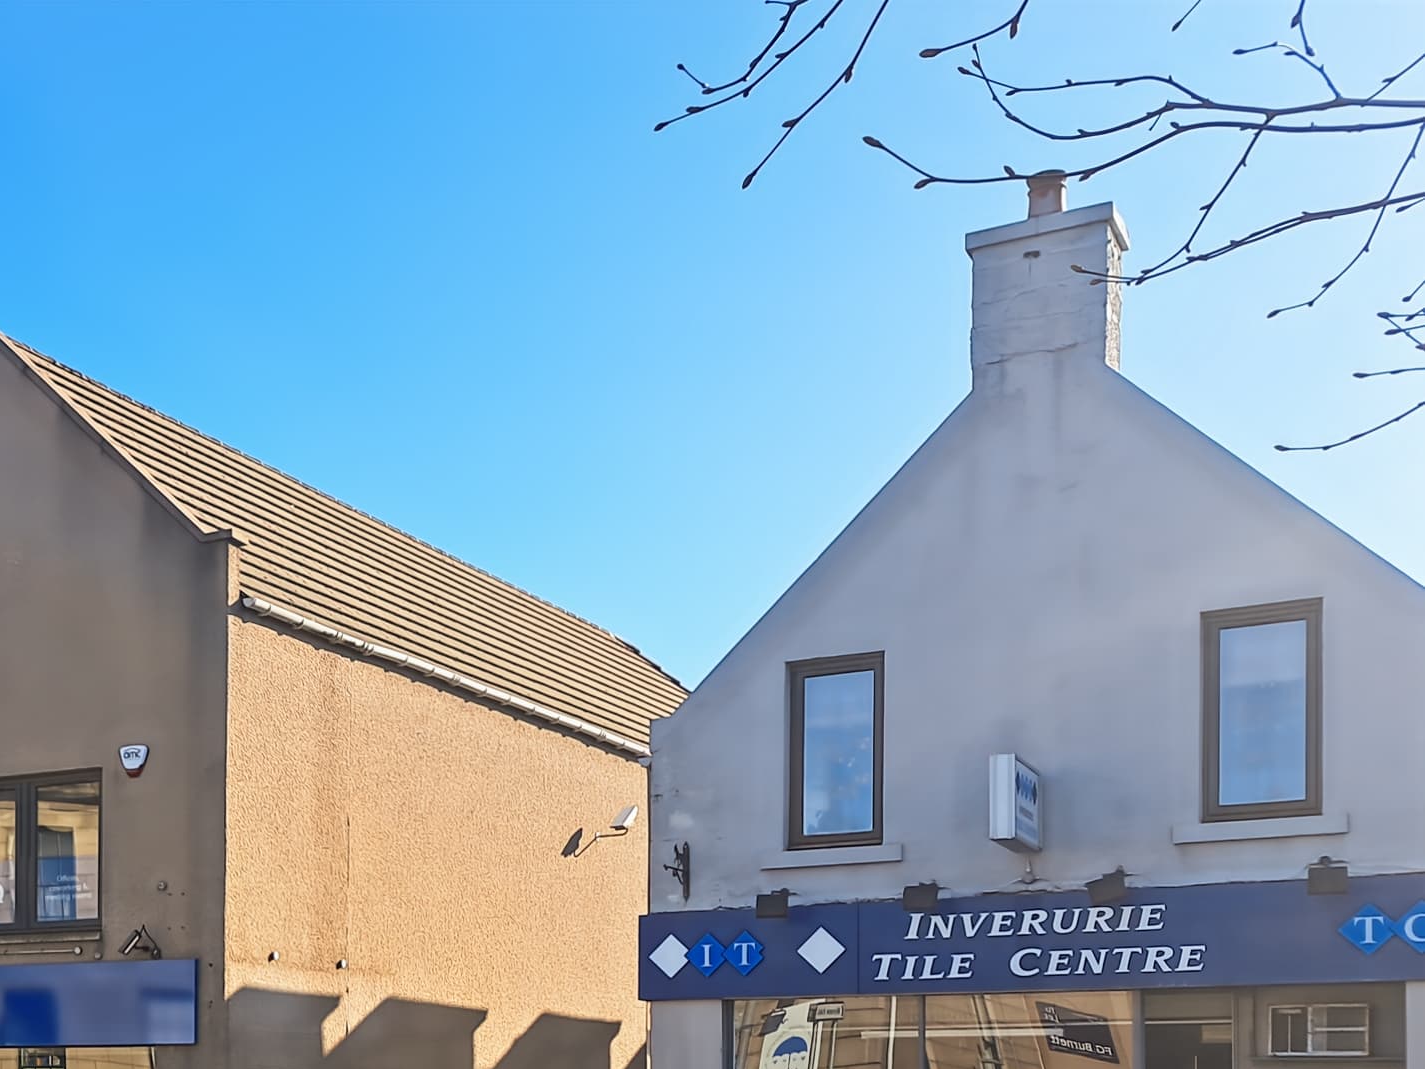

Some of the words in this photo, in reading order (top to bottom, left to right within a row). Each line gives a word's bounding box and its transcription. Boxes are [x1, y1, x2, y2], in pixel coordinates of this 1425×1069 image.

[903, 903, 1167, 940] INVERURIE
[872, 952, 975, 981] TILE
[1009, 944, 1207, 978] CENTRE
